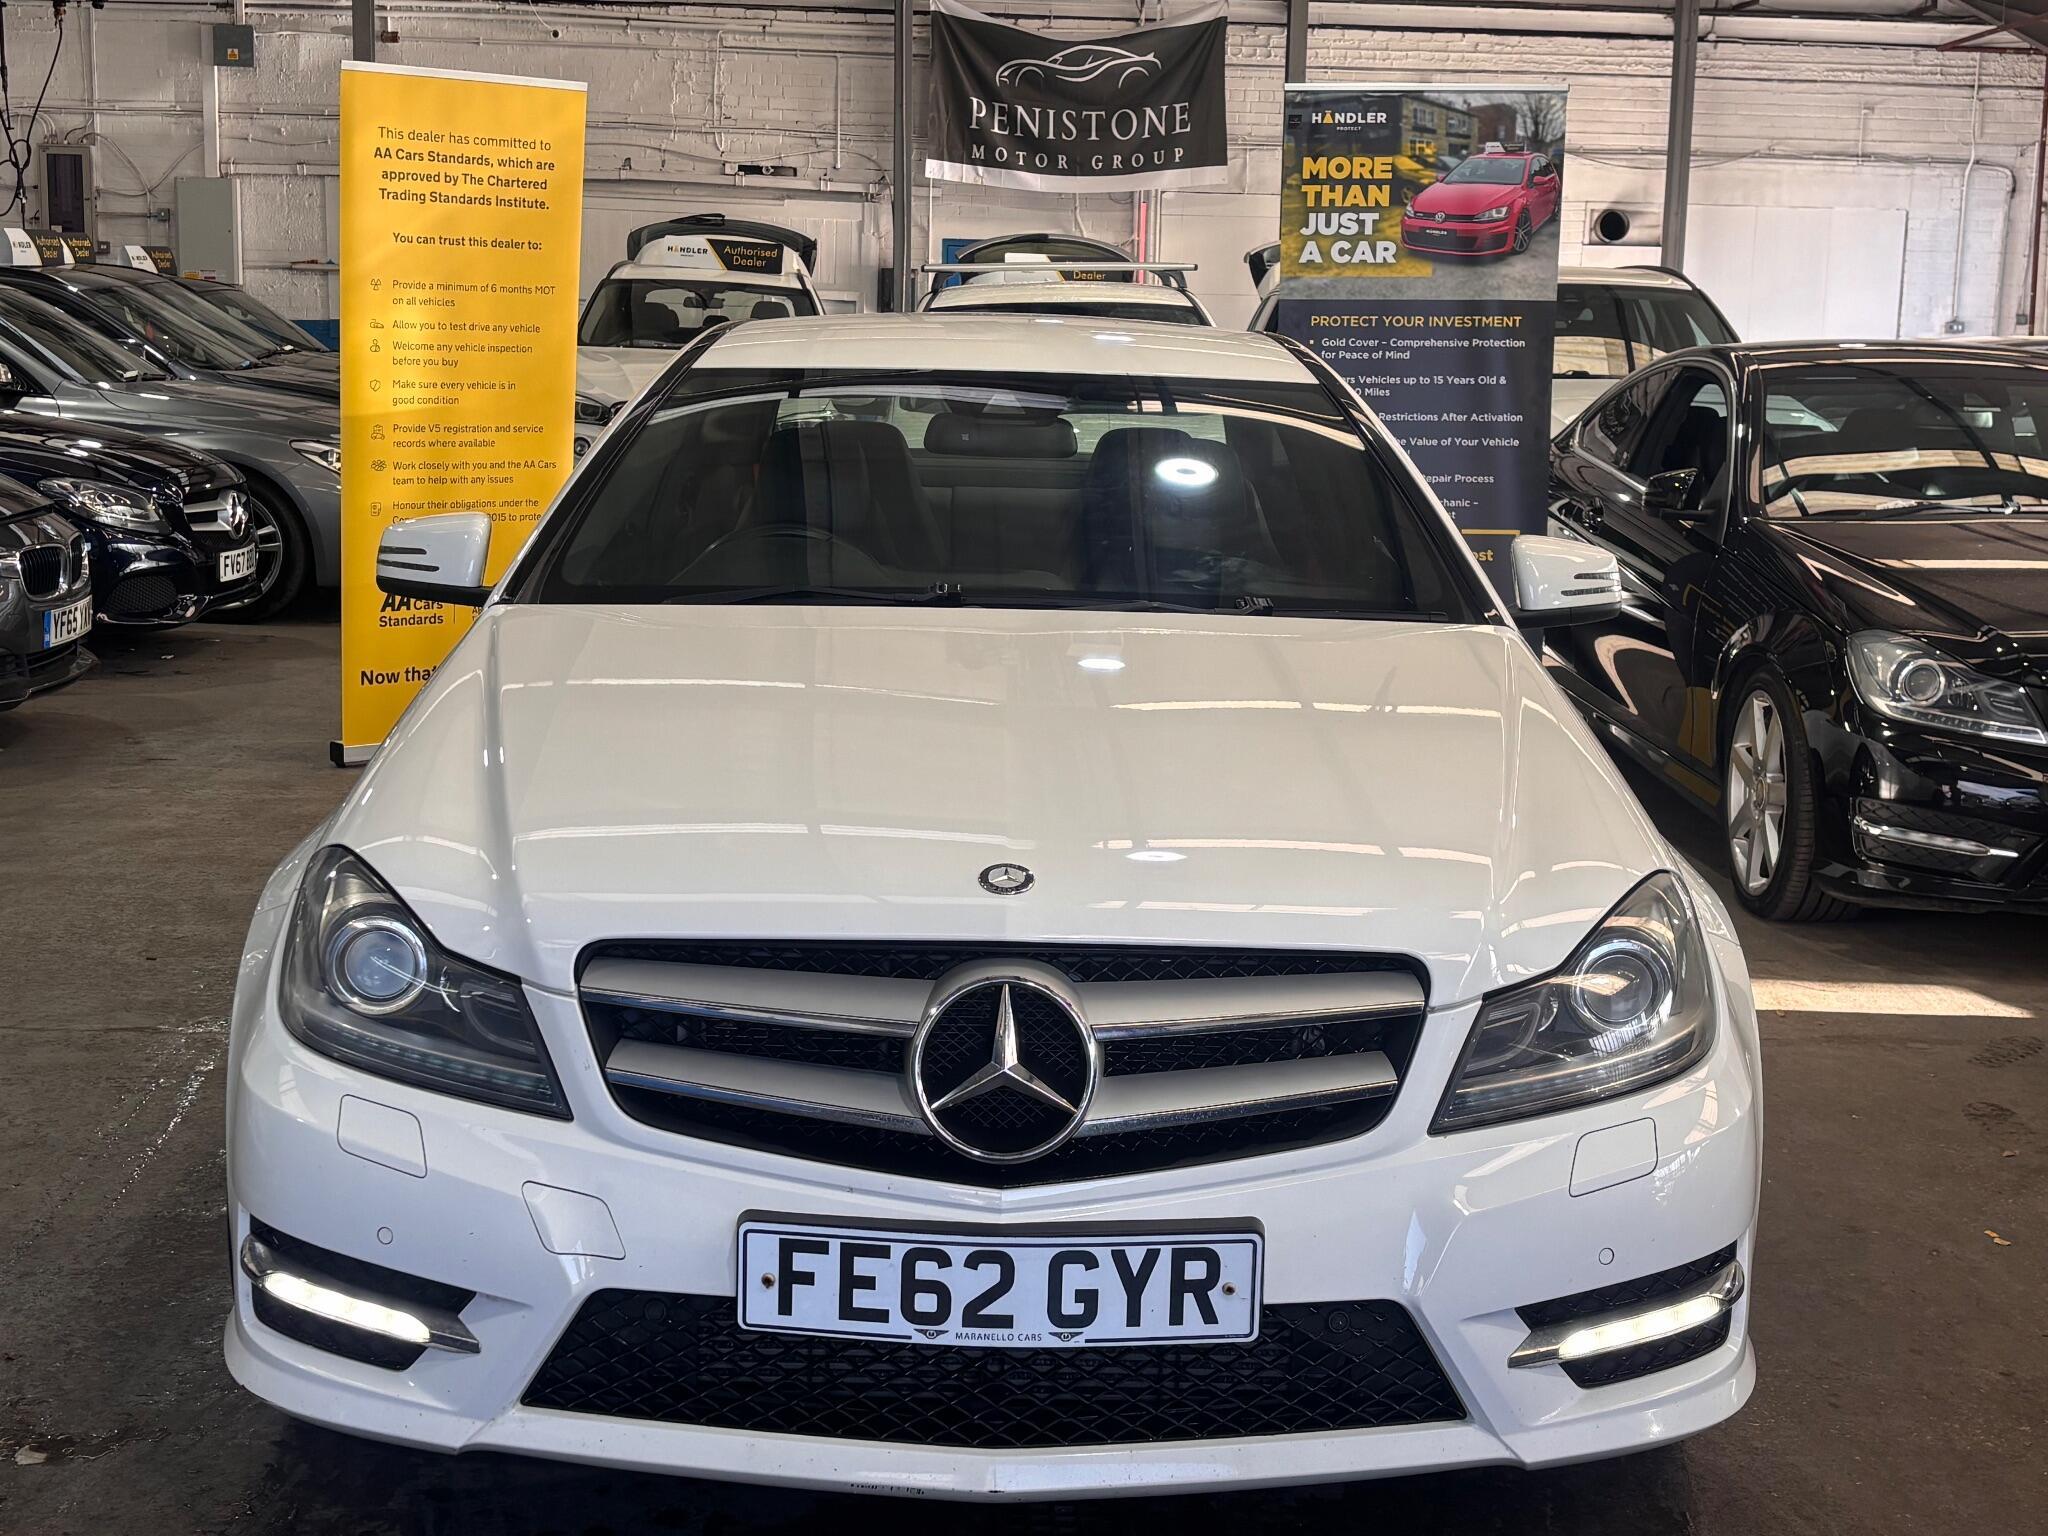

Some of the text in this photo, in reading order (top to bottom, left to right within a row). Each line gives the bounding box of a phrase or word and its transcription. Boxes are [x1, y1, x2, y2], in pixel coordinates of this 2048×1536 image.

[969, 96, 1190, 141] PENISTONE
[378, 127, 551, 151] This dealer has committed to
[374, 148, 554, 171] AA Cars Standards, which are
[972, 144, 1185, 169] MOTOR GROUP
[1302, 157, 1392, 179] MORE
[382, 170, 547, 190] approved by The Chartered
[379, 188, 549, 210] Trading Standards Institute.
[1301, 185, 1390, 207] THAN
[1300, 213, 1379, 235] JUST
[393, 233, 542, 250] You can trust this dealer to:
[724, 246, 777, 258] Authorised
[1299, 241, 1396, 264] A CAR
[733, 256, 766, 267] Dealer
[1073, 271, 1106, 280] Dealer
[392, 280, 556, 294] Provide a minimum of 6 months MOT
[406, 297, 416, 306] all
[419, 297, 455, 307] vehicles
[392, 320, 540, 334] Allow you to test drive any vehicle
[1311, 316, 1522, 327] PROTECT YOUR INVESTMENT
[392, 341, 532, 356] Welcome any vehicle inspection
[1322, 338, 1346, 347] Gold
[1349, 338, 1379, 347] Cover
[1390, 338, 1469, 349] Comprehensive
[1472, 338, 1525, 347] Protection
[1321, 350, 1410, 359] for Peace of Mind
[392, 357, 458, 369] before you buy
[392, 380, 515, 392] Make sure every vehicle is in
[1358, 376, 1400, 384] Vehicles
[1433, 376, 1443, 384] 15
[1446, 376, 1475, 384] Years
[1479, 376, 1497, 384] Old
[1499, 376, 1506, 384] &
[1365, 388, 1390, 396] Miles
[392, 395, 459, 406] good condition
[1379, 413, 1523, 422] Restrictions After Activation
[393, 424, 543, 436] Provide V5 registration and service
[393, 437, 495, 448] records where available
[1410, 438, 1438, 446] Value
[1441, 438, 1451, 446] of
[1454, 438, 1479, 446] Your
[1482, 438, 1519, 446] Vehicle
[393, 460, 557, 472] Work closely with you and the AA Cars
[393, 475, 513, 487] team to help with any issues
[1455, 475, 1494, 483] Process
[393, 501, 424, 510] Honour
[428, 500, 446, 509] their
[450, 499, 496, 510] obligations
[509, 513, 516, 521] to
[519, 513, 541, 522] prote
[224, 552, 245, 576] FV67
[380, 593, 443, 612] AA Cars
[53, 607, 78, 639] YF65
[379, 614, 443, 627] Standards
[361, 670, 400, 685] Now
[776, 1237, 1221, 1329] FE62 GYR
[955, 1332, 1042, 1341] MARANELLO CARS
